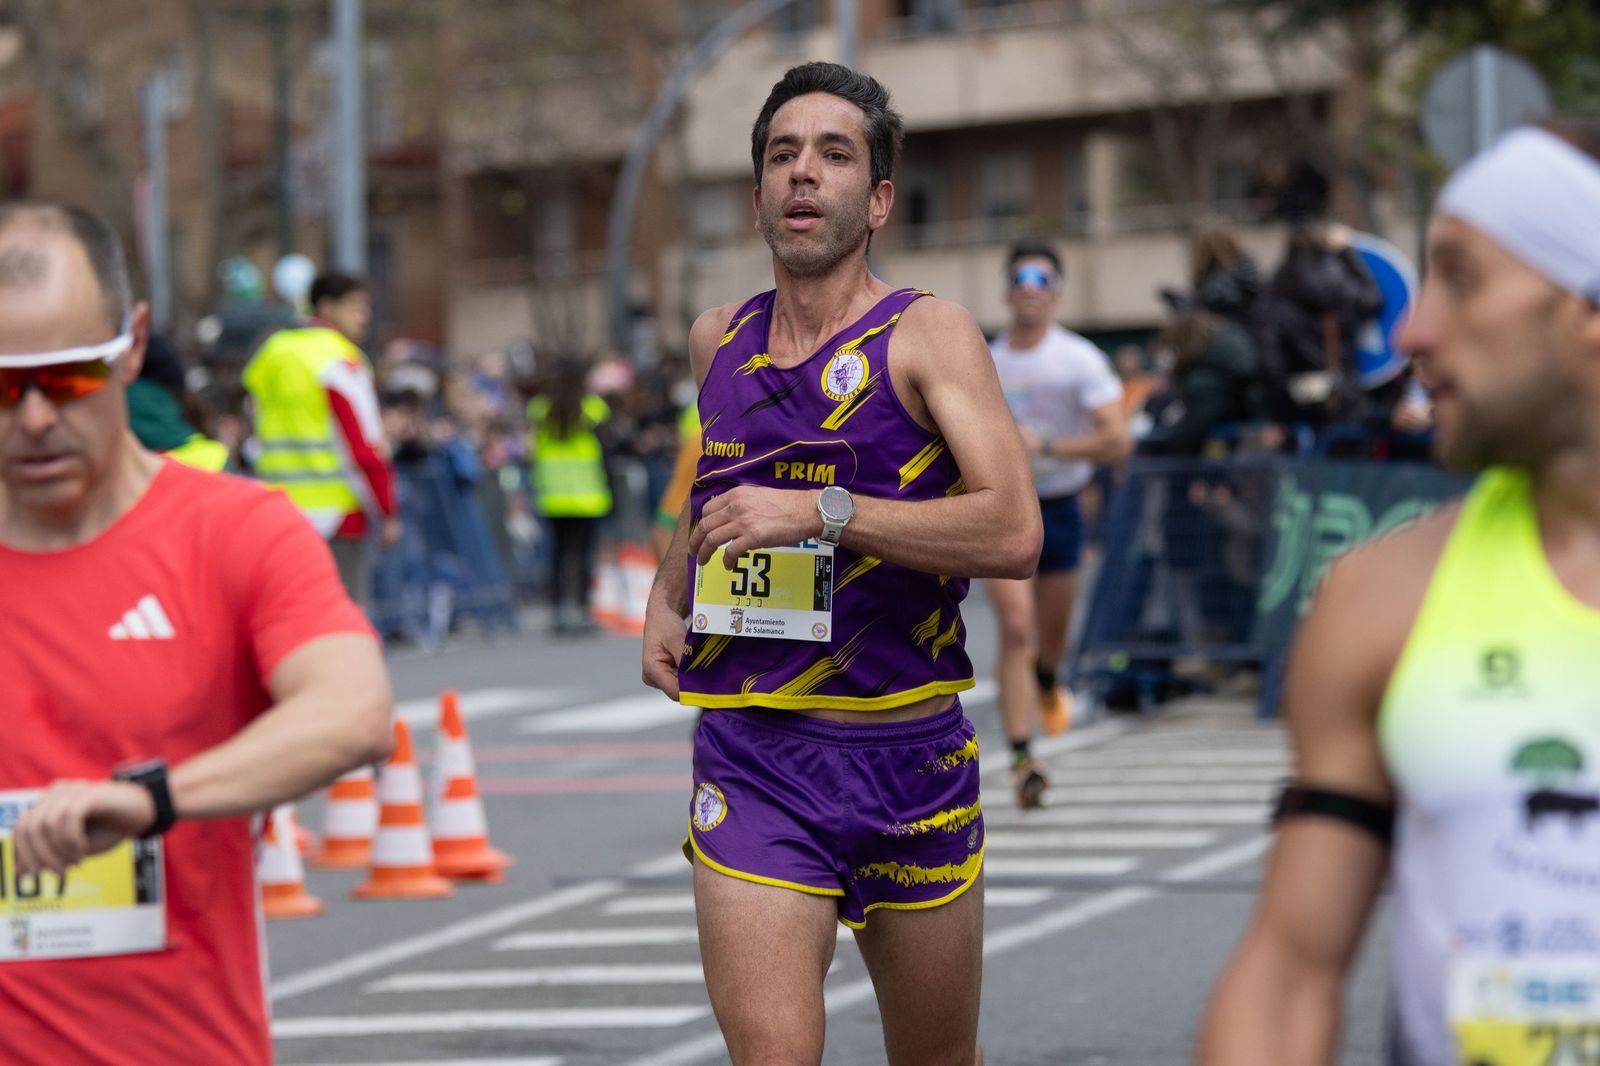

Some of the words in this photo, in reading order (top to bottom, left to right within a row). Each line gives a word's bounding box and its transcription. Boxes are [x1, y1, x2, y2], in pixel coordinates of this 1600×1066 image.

[775, 461, 836, 485] PRIM
[731, 552, 771, 598] 53
[745, 617, 785, 627] Ayuntamiento
[753, 627, 785, 635] Salamanca
